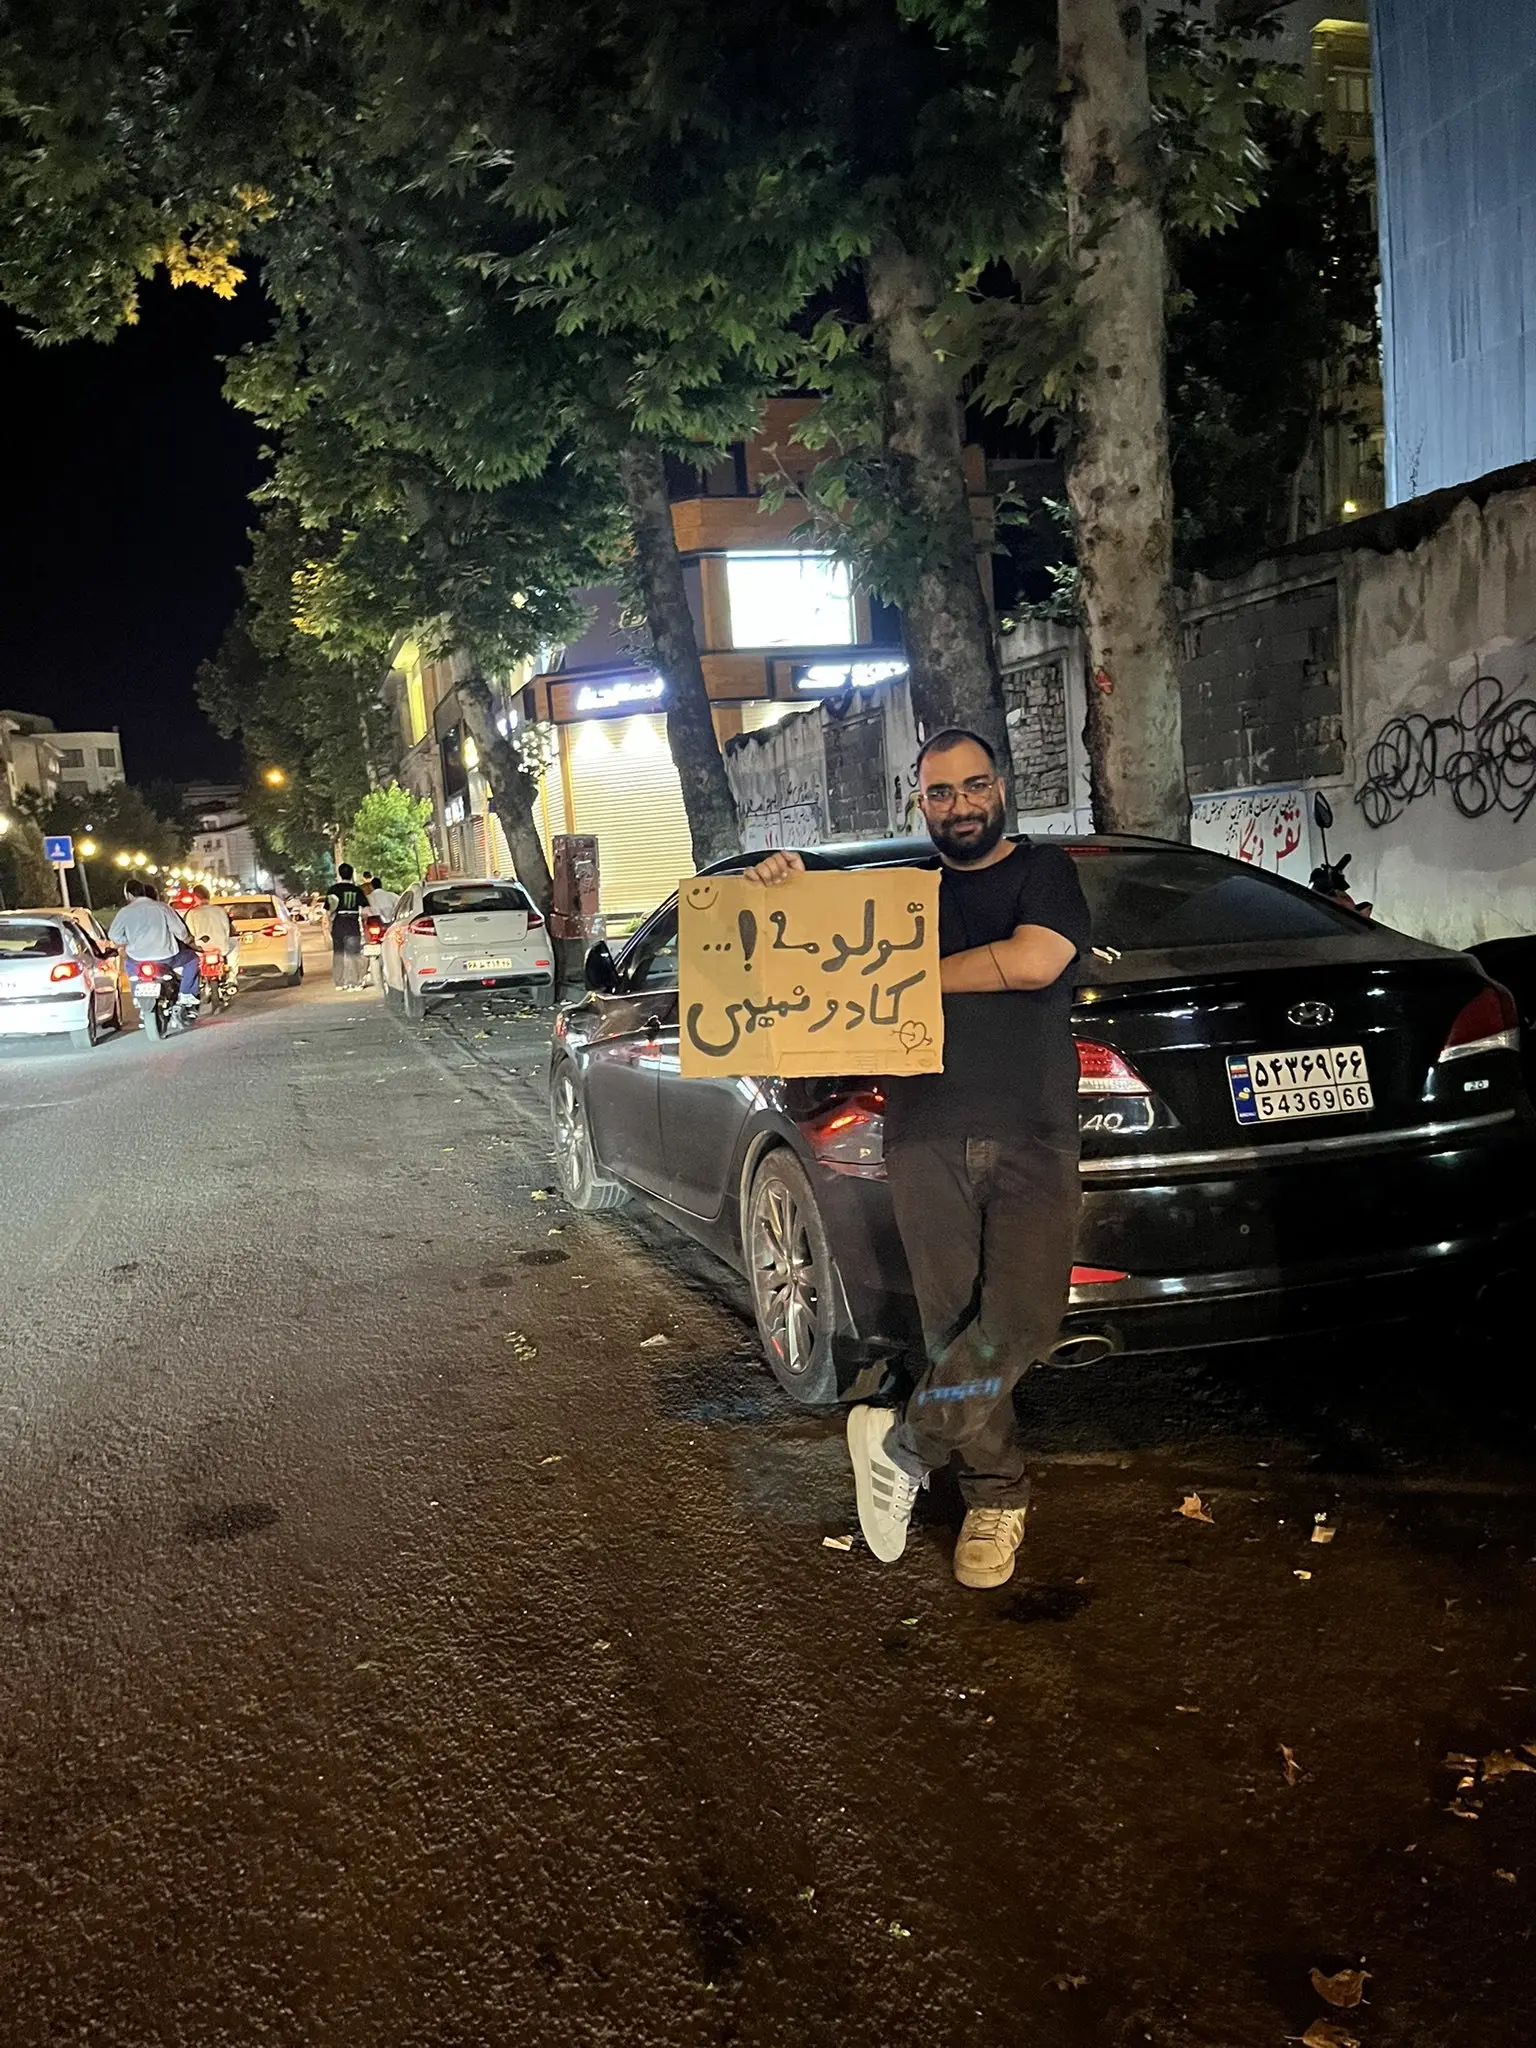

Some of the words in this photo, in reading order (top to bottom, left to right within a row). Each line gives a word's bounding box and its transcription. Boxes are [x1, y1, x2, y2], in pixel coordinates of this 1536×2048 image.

[808, 969, 927, 1033] کادو
[1255, 1053, 1331, 1088] ۵۴۳۶۹
[1335, 1051, 1362, 1080] ۶۶
[1262, 1089, 1335, 1116] 54369
[1343, 1086, 1369, 1107] 66
